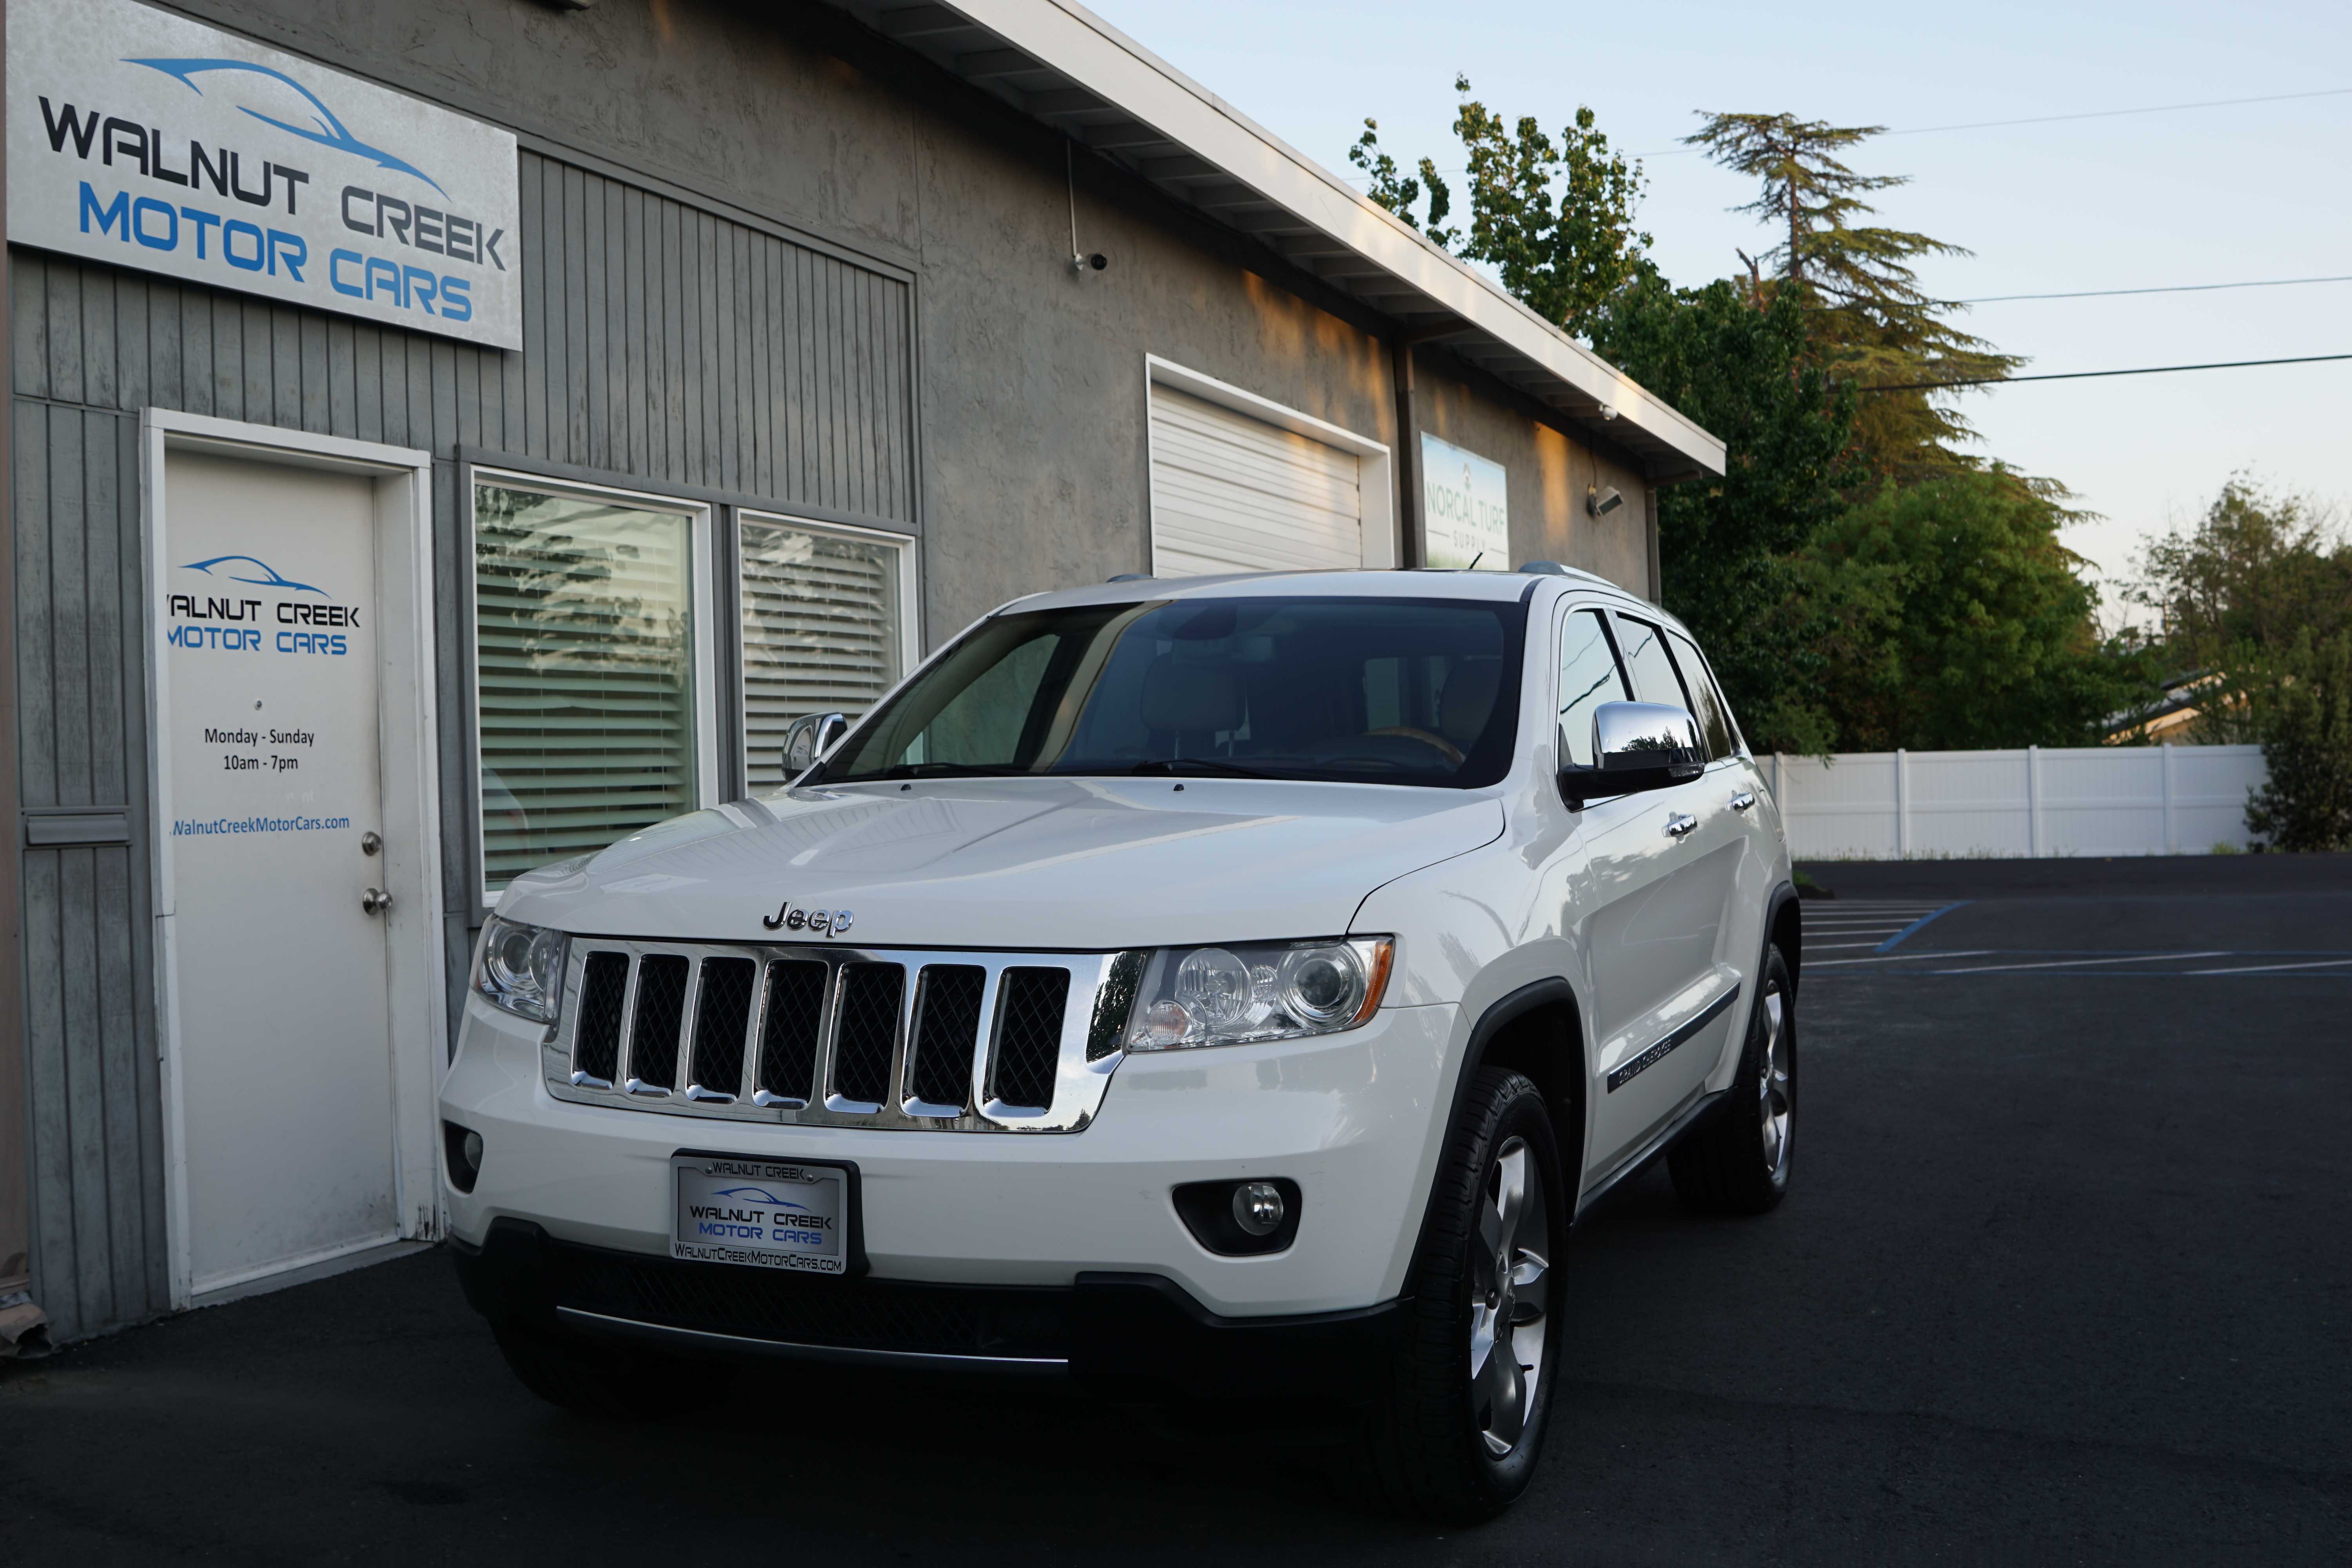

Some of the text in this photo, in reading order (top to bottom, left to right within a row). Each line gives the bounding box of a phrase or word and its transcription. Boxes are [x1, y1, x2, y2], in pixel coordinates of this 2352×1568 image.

[38, 95, 506, 272] WALNUT CREEK
[79, 180, 472, 323] MOTOR CARS
[1426, 481, 1505, 535] NORCAL TURF
[1454, 530, 1485, 553] SUPPLY
[166, 594, 360, 628] ALNUT CREEK
[167, 626, 347, 655] MOTOR CARS
[205, 728, 258, 747] Monday
[270, 729, 314, 747] Sunday
[224, 755, 259, 770] 10am
[271, 755, 298, 773] 7pm
[763, 901, 854, 938] Jeep
[1619, 1038, 1671, 1084] GRAND CHEROKEE
[712, 1161, 804, 1180] WALNUT CREEK
[690, 1205, 832, 1230] WALNUT CREEK
[699, 1222, 822, 1245] MOTOR CARS
